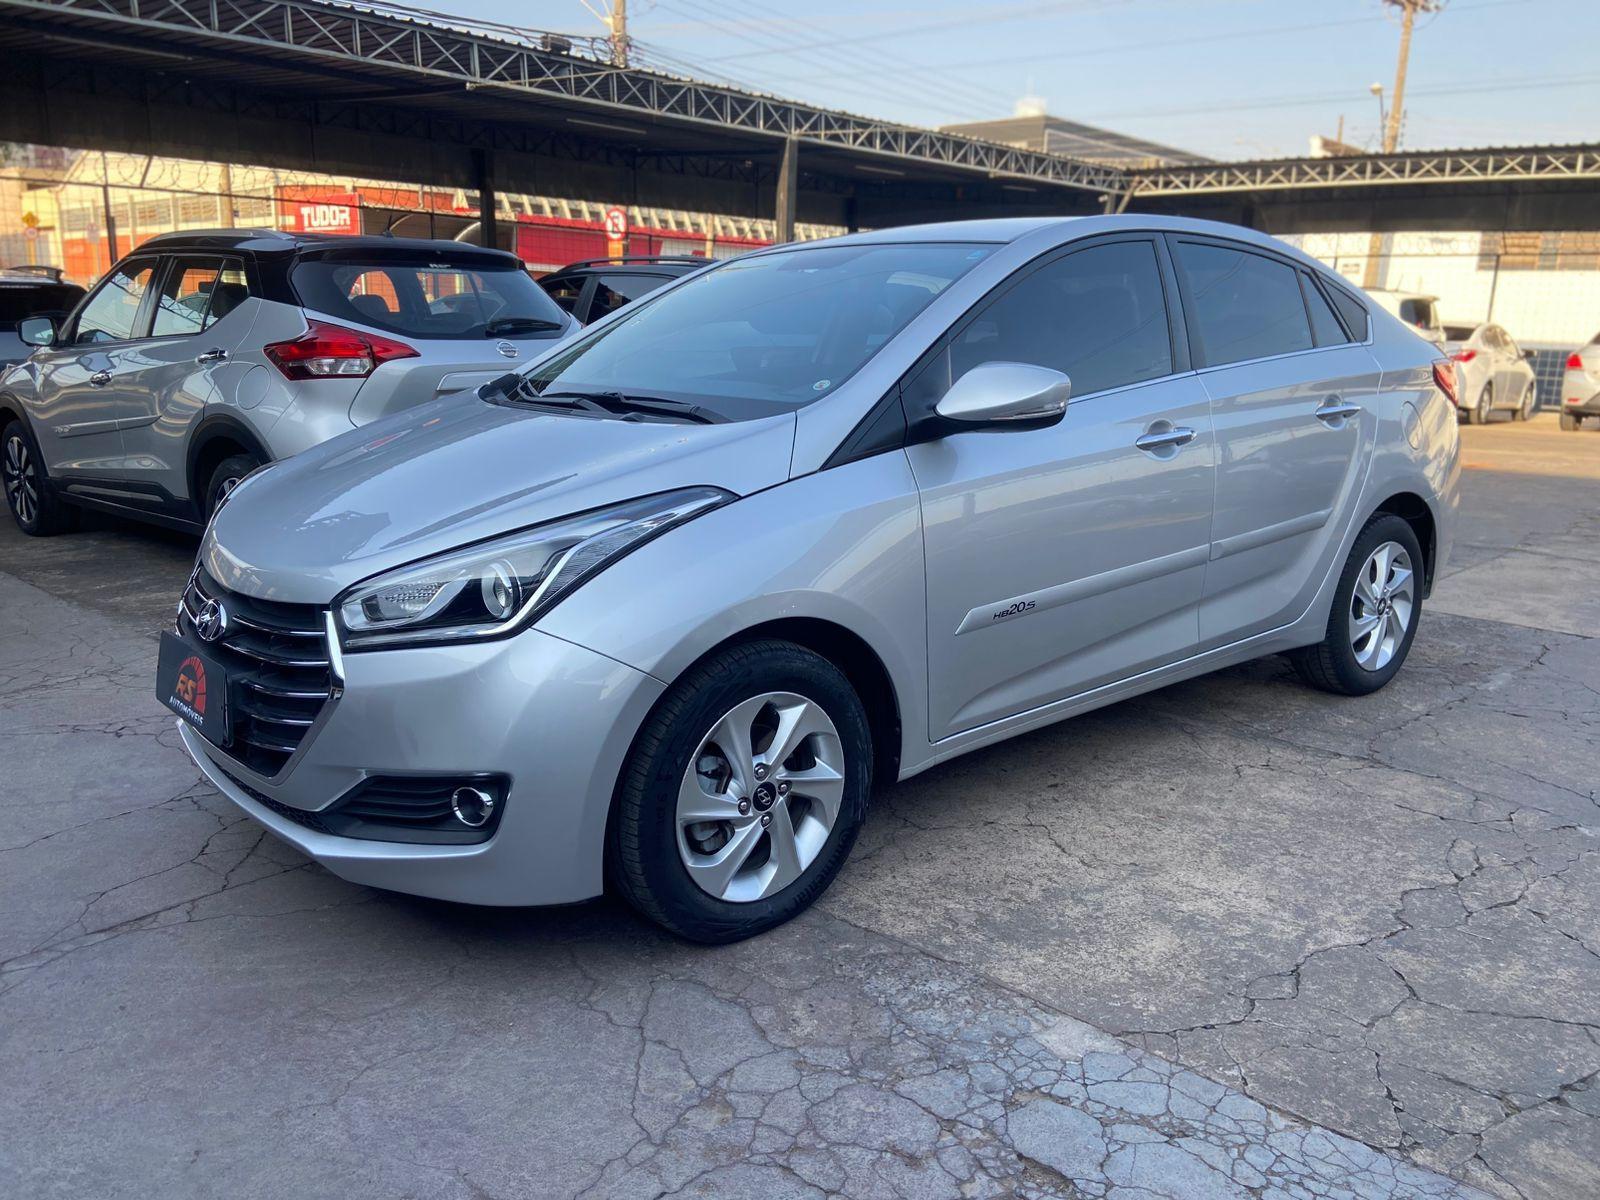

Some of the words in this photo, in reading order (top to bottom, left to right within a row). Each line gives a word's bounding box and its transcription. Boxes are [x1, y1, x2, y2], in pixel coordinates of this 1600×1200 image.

[300, 204, 351, 227] TUDOR
[175, 673, 197, 702] RS
[168, 695, 204, 726] AUTOMÓVEIS
